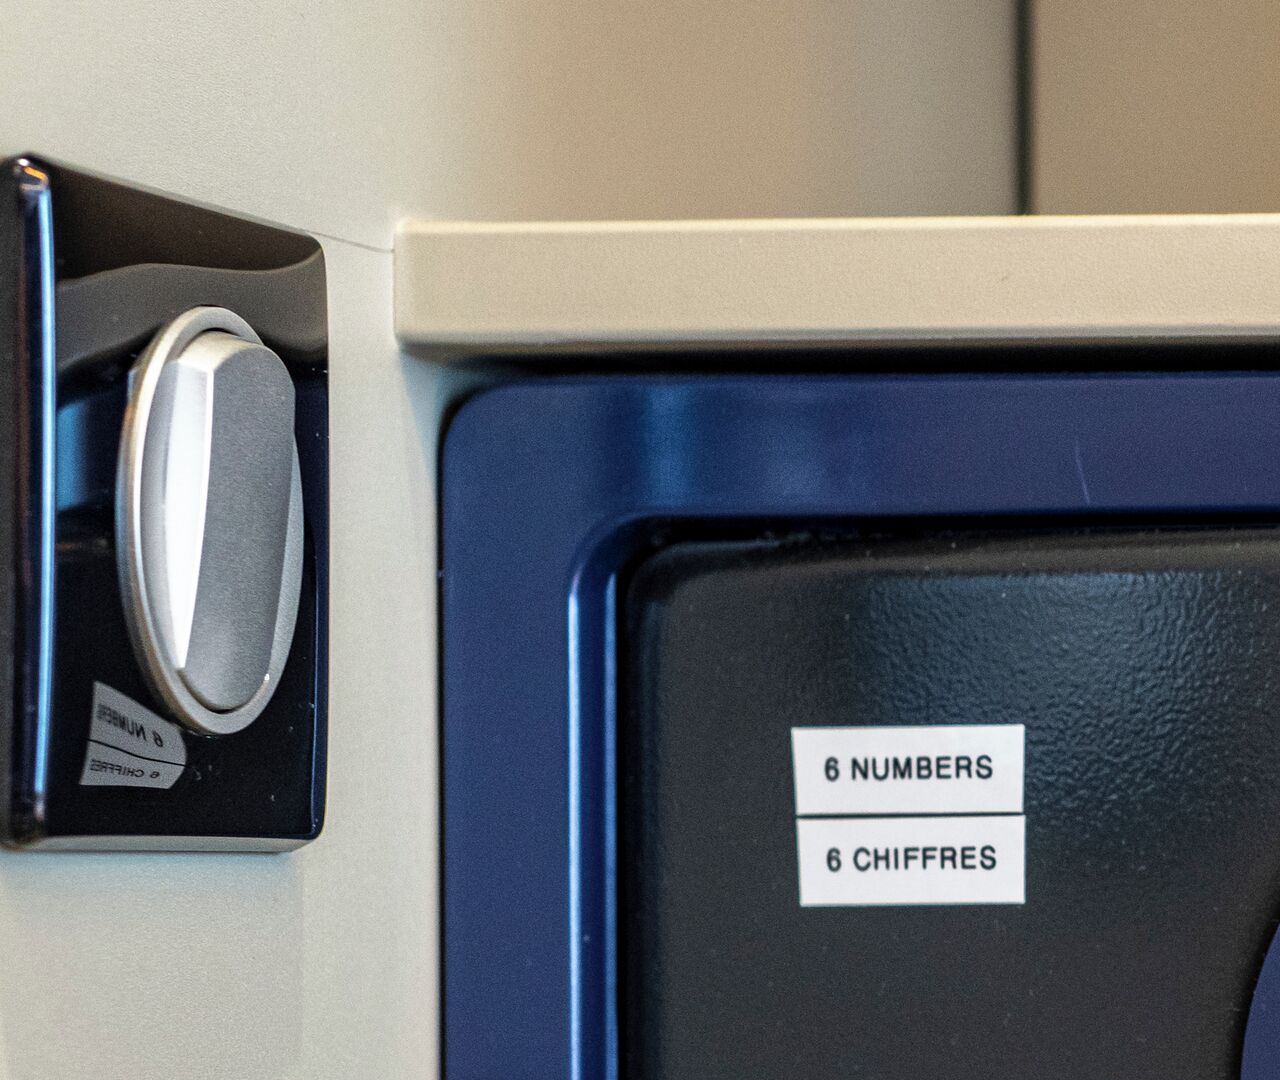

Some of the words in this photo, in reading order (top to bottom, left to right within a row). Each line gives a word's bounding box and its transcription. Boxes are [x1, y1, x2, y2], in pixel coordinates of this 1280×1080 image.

[824, 756, 840, 782] 6
[851, 754, 993, 782] NUMBERS
[826, 847, 842, 873] 6
[852, 845, 997, 872] CHIFFRES
